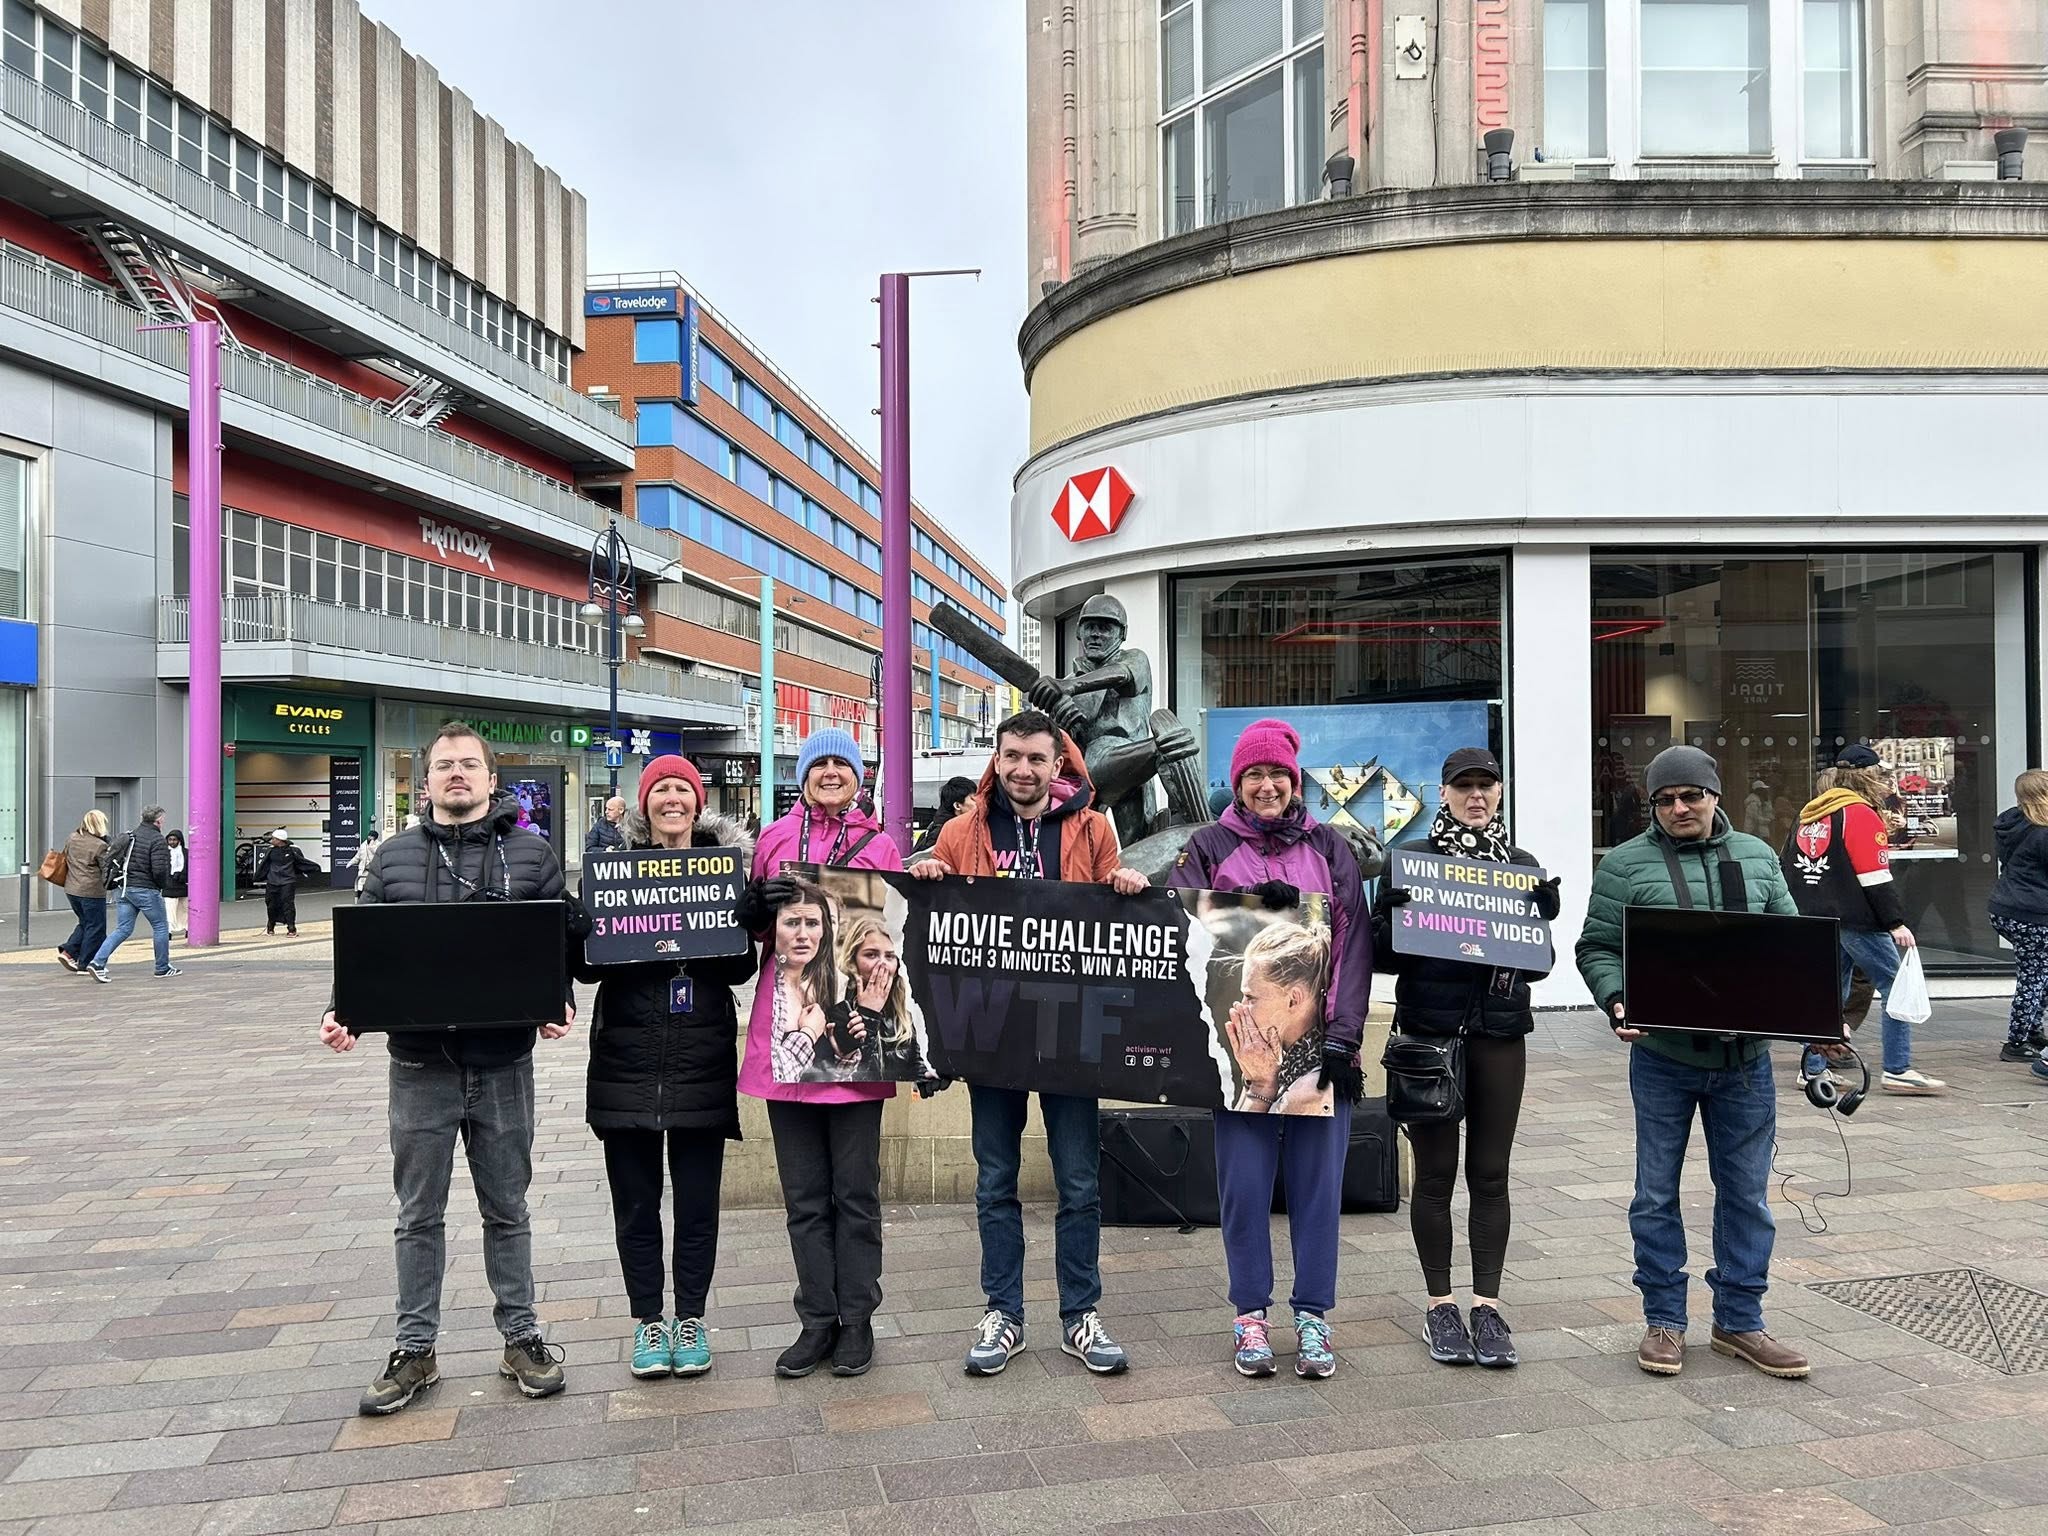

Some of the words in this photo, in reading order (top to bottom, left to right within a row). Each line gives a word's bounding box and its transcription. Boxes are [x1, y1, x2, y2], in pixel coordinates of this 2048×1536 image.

[613, 296, 668, 309] Travelodge
[275, 704, 343, 720] EVANS
[289, 723, 331, 735] CYCLES
[573, 729, 588, 743] D
[725, 759, 743, 777] C&S
[593, 861, 632, 880] WIN
[638, 859, 682, 878] FREE
[687, 856, 734, 876] FOOD
[1401, 858, 1439, 879] WIN
[1444, 864, 1488, 885] FREE
[1493, 870, 1539, 891] FOOD
[594, 890, 628, 907] FOR
[631, 884, 721, 906] WATCHING
[724, 884, 736, 900] A
[1438, 889, 1526, 916] WATCHING
[1529, 902, 1541, 918] A
[595, 918, 606, 936] 3
[612, 913, 682, 935] MINUTE
[928, 911, 1014, 948] MOVIE
[1021, 917, 1179, 958] CHALLENGE
[1402, 910, 1413, 927] 3
[1418, 912, 1487, 937] MINUTE
[1491, 921, 1544, 945] VIDEO
[927, 944, 982, 967] WATCH
[986, 948, 997, 969] 3
[1001, 949, 1076, 976] MINUTES,
[1081, 955, 1112, 977] WIN
[1115, 957, 1127, 978] A
[1131, 958, 1177, 980] PRIZE
[928, 973, 1135, 1064] WTF
[1125, 1045, 1172, 1055] activism.wtf
